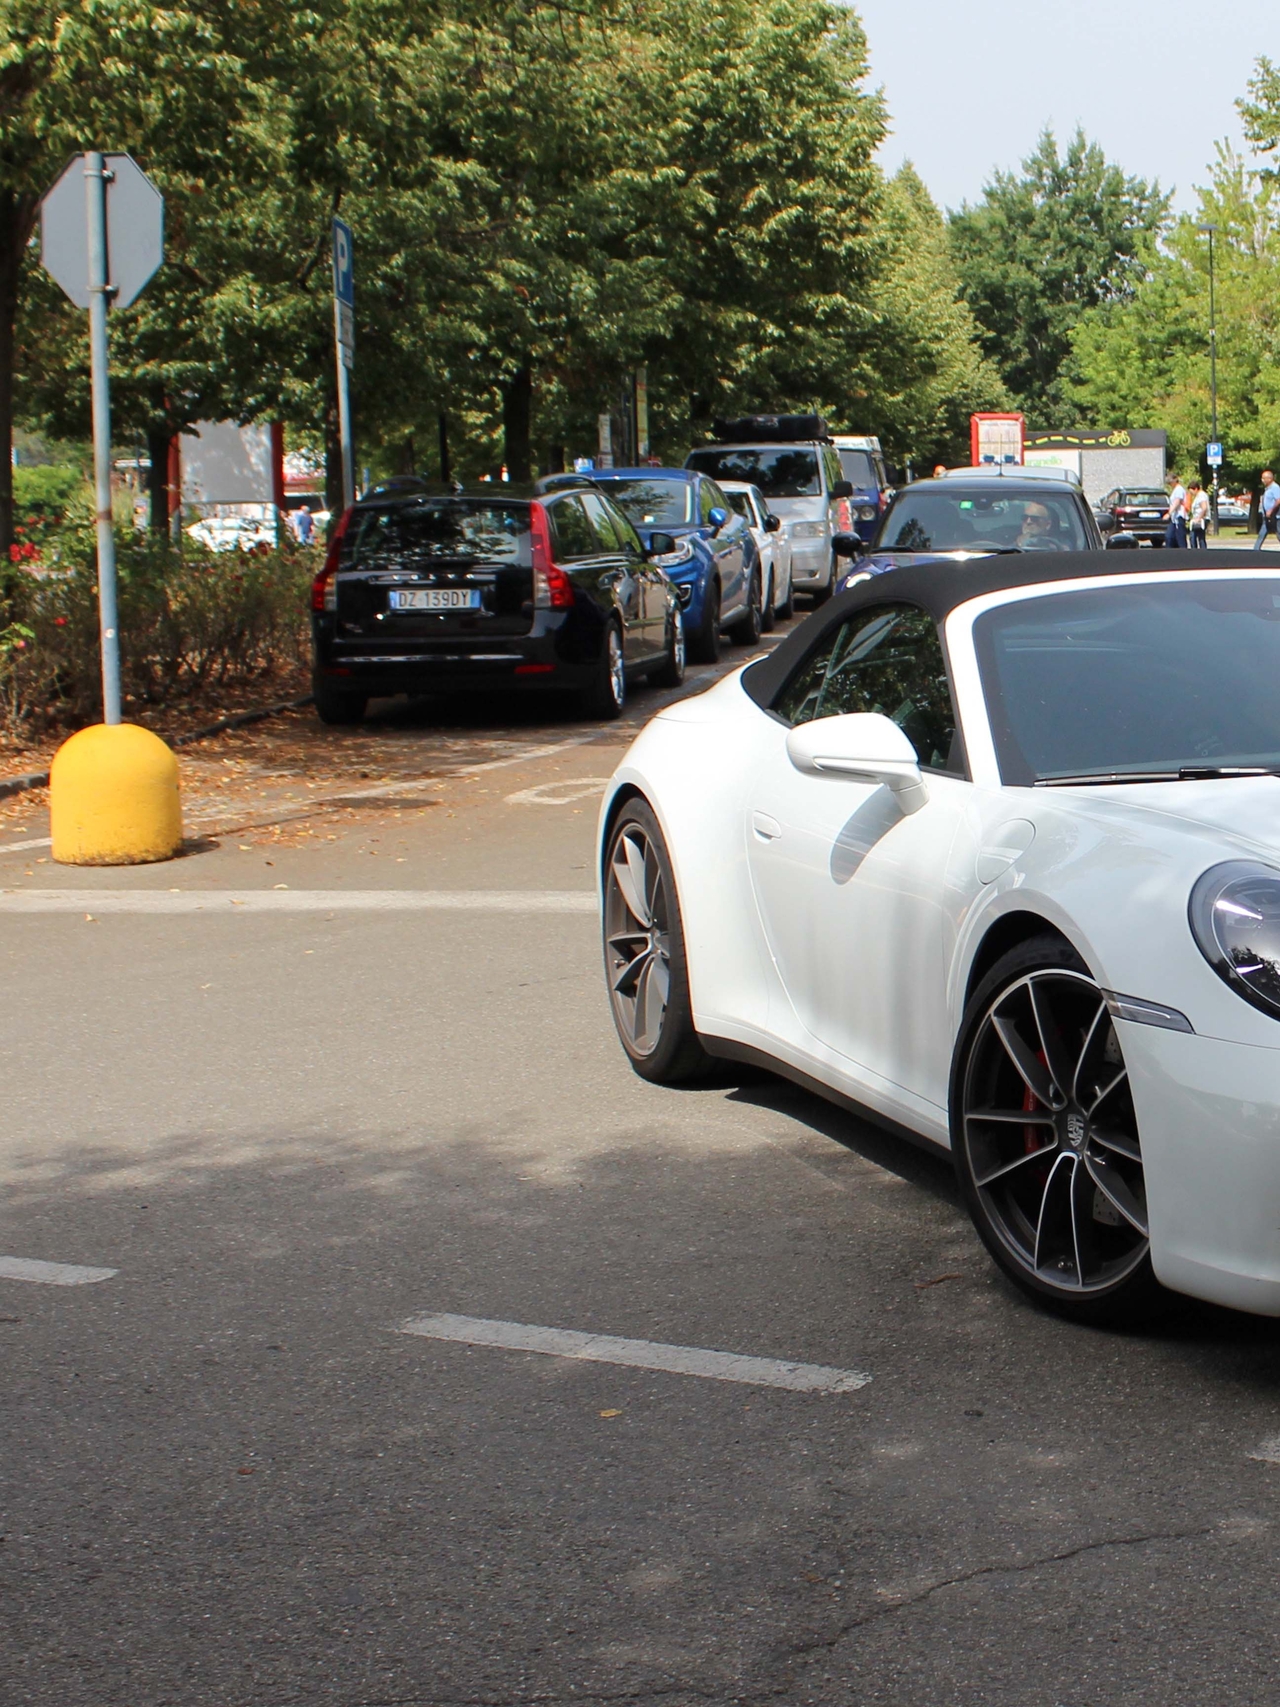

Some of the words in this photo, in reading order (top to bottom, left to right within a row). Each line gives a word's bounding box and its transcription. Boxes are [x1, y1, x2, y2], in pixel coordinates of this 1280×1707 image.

[336, 226, 348, 292] P
[1210, 445, 1219, 456] P
[399, 592, 416, 607] DZ
[424, 591, 469, 607] 139DY
